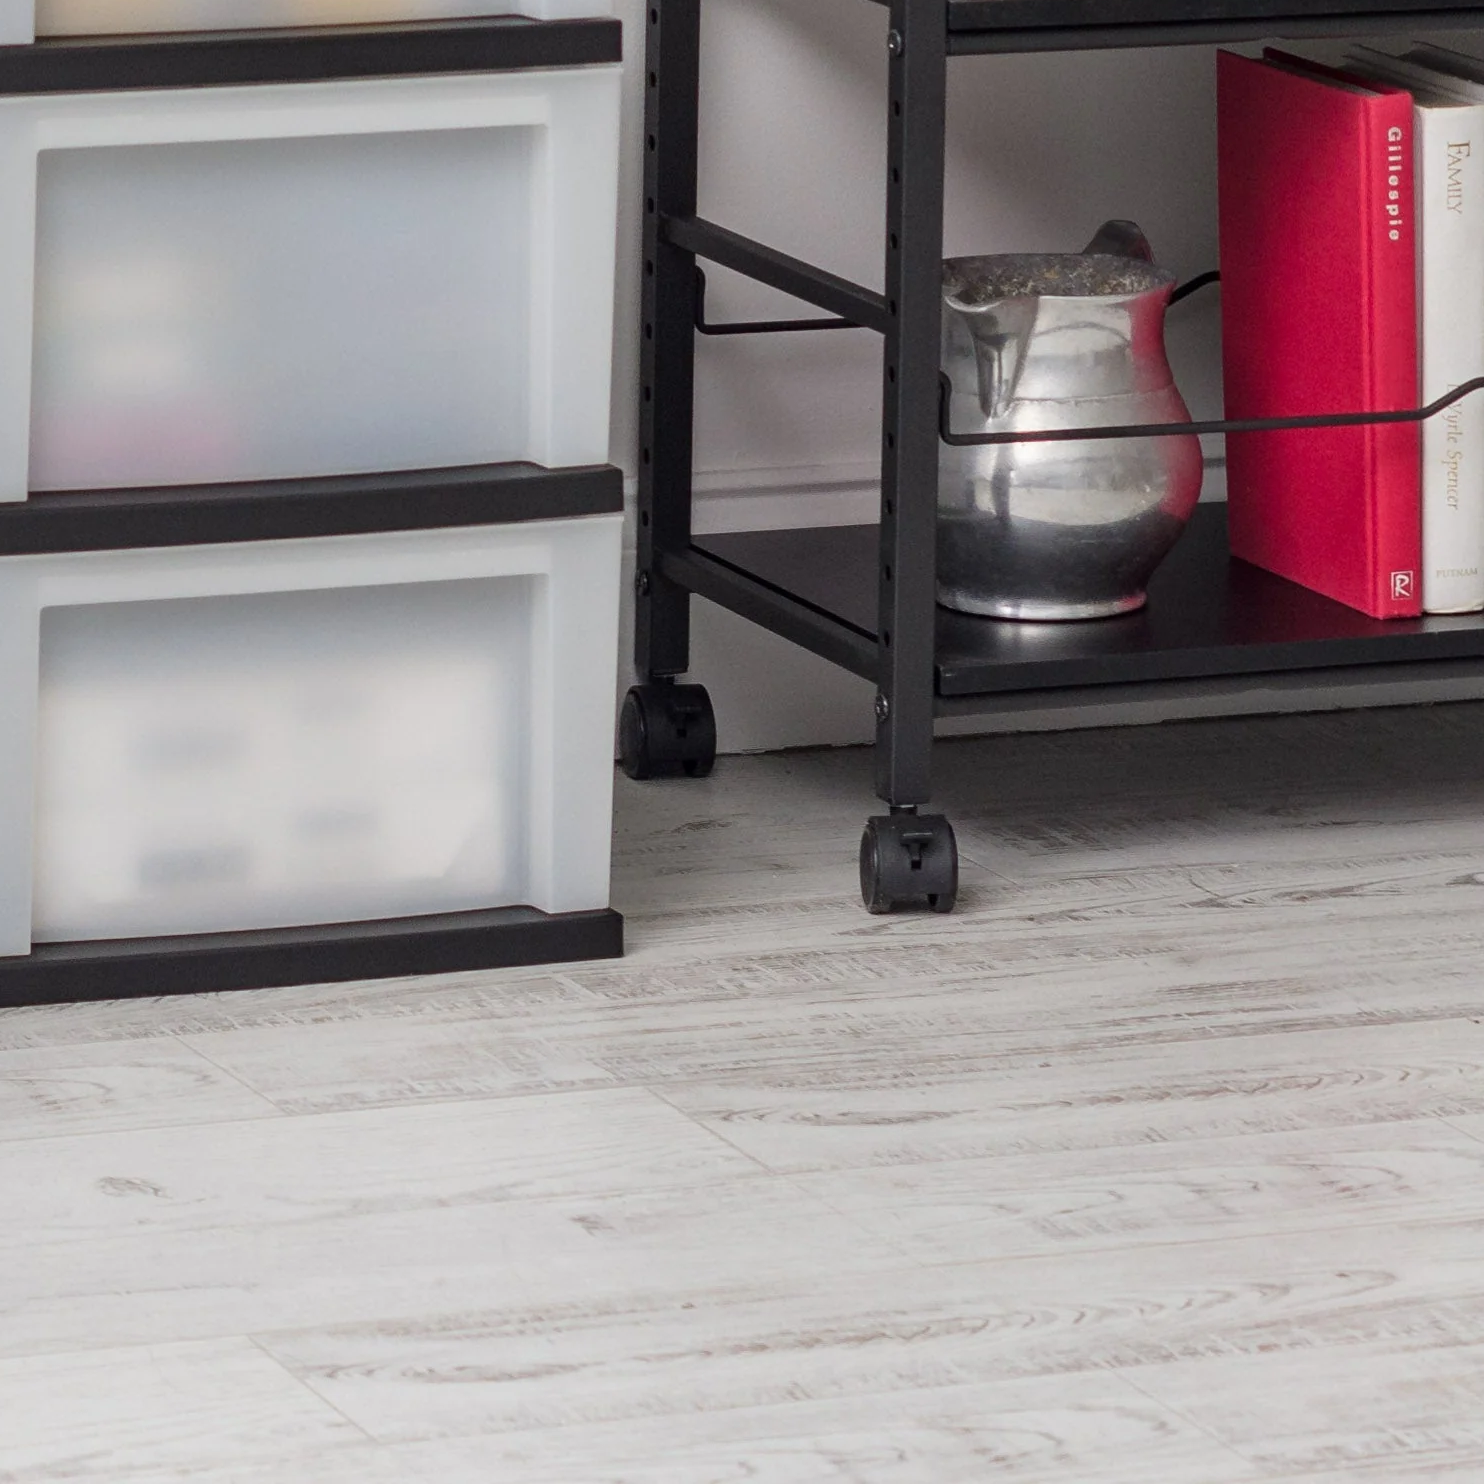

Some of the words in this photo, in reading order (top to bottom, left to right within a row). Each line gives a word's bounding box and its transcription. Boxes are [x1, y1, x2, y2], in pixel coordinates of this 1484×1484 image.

[1385, 126, 1403, 241] Gillespie
[1447, 140, 1471, 215] FAMILY
[1441, 384, 1463, 443] LVyrle
[1441, 451, 1463, 510] Spencer
